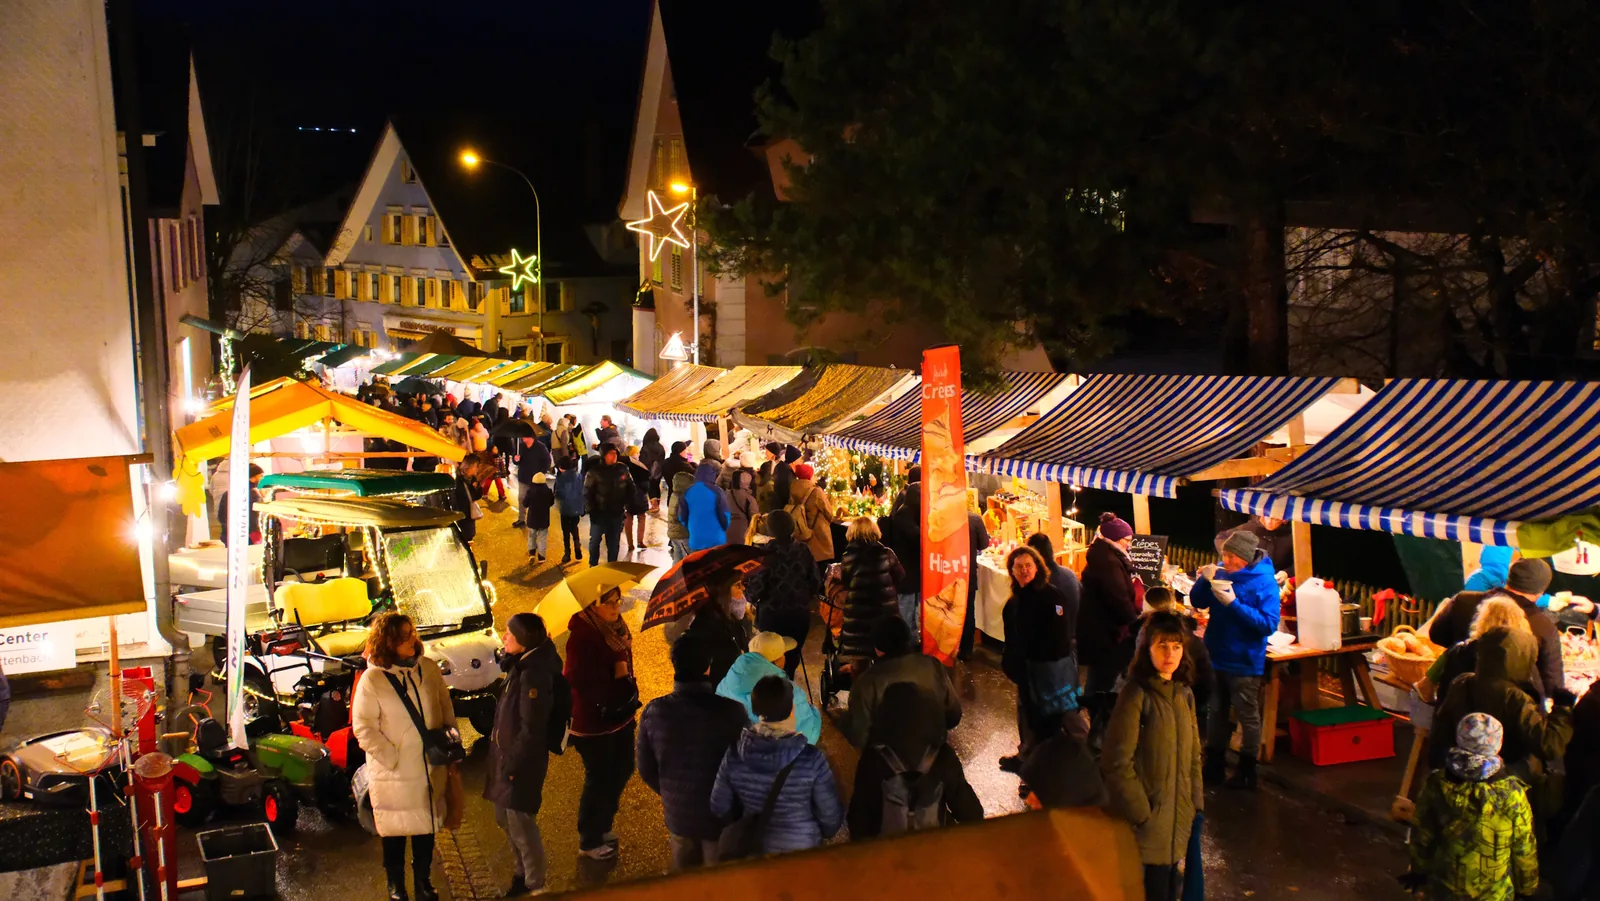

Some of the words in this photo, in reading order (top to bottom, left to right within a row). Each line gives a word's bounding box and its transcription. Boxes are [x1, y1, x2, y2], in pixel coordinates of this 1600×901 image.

[922, 382, 957, 399] Crêes
[929, 552, 968, 575] Hier!
[0, 654, 51, 666] tenbac
